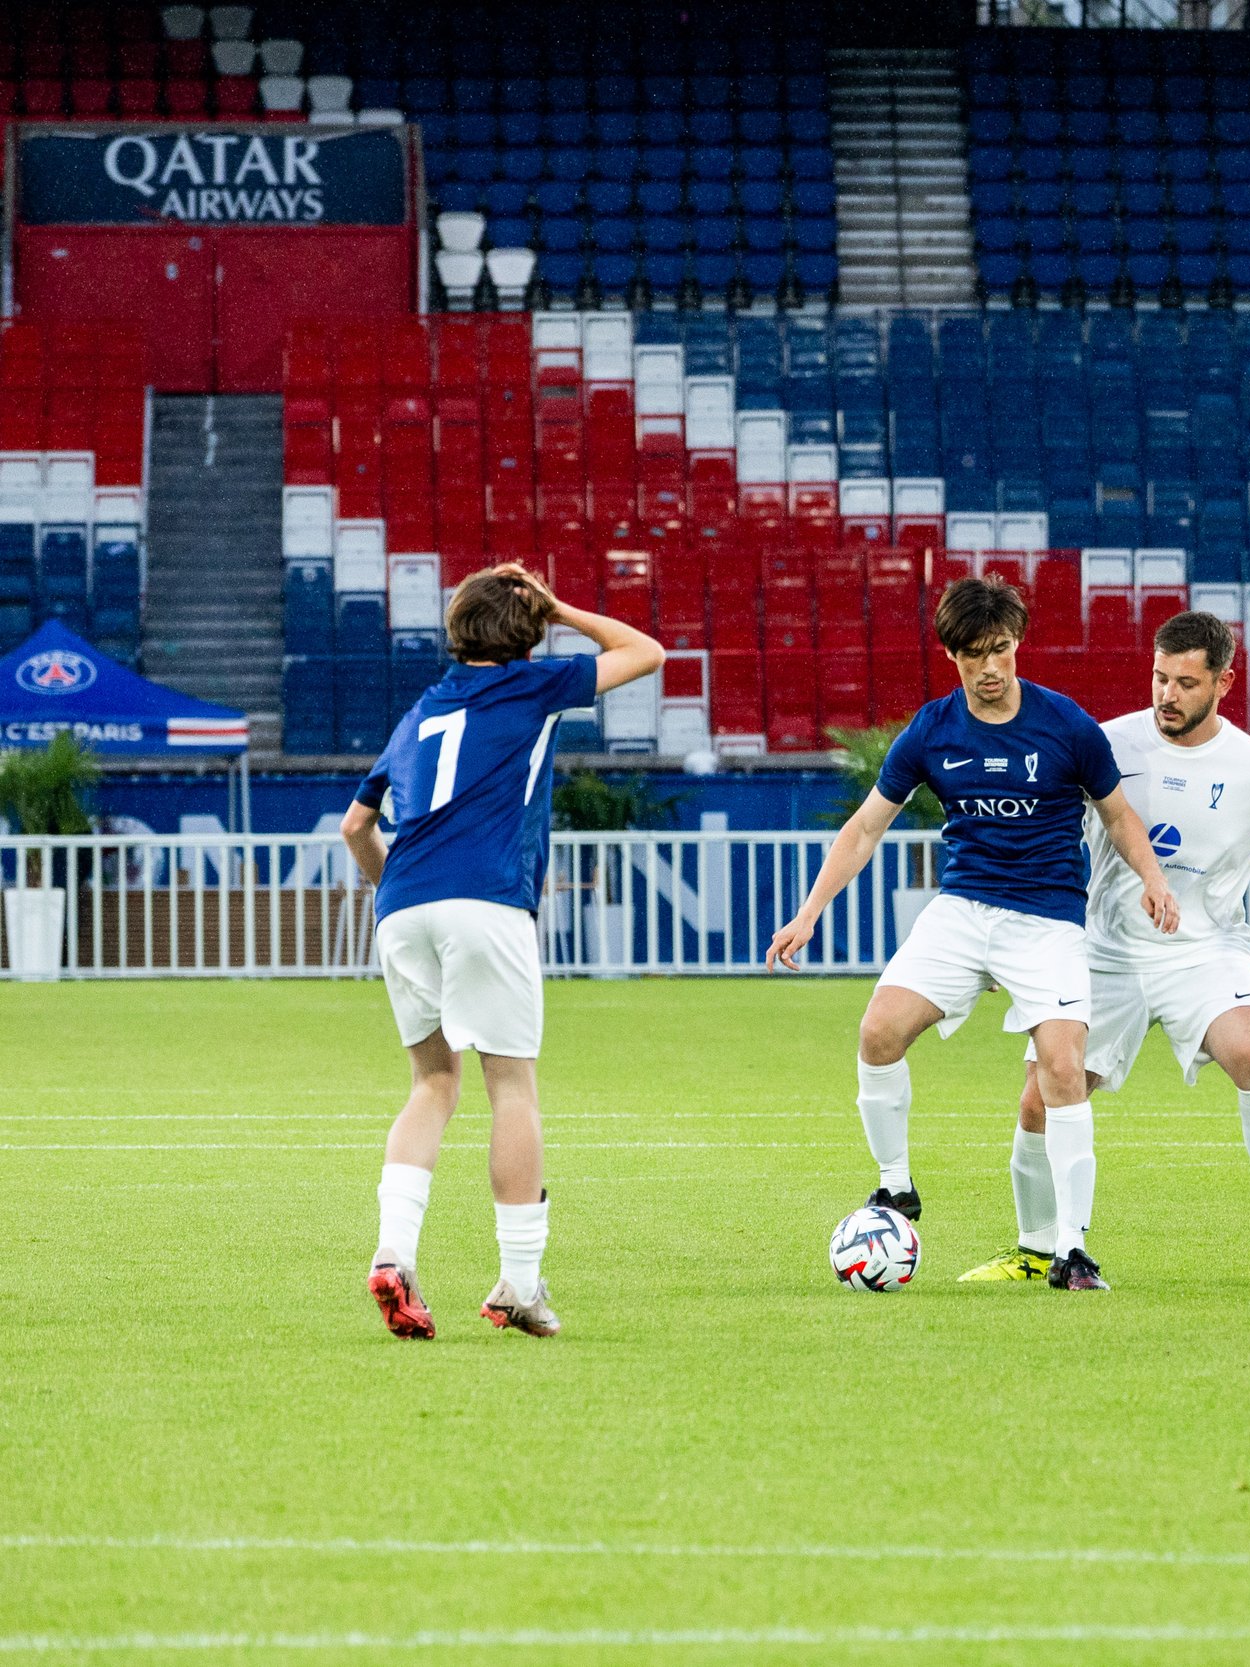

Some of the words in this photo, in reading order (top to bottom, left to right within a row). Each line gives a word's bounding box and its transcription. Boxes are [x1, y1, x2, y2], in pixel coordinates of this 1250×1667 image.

[104, 134, 322, 196] QATAR
[161, 189, 324, 220] AIRWAYS
[73, 722, 143, 741] PARIS
[418, 708, 467, 812] 7
[957, 799, 1039, 817] LNQV
